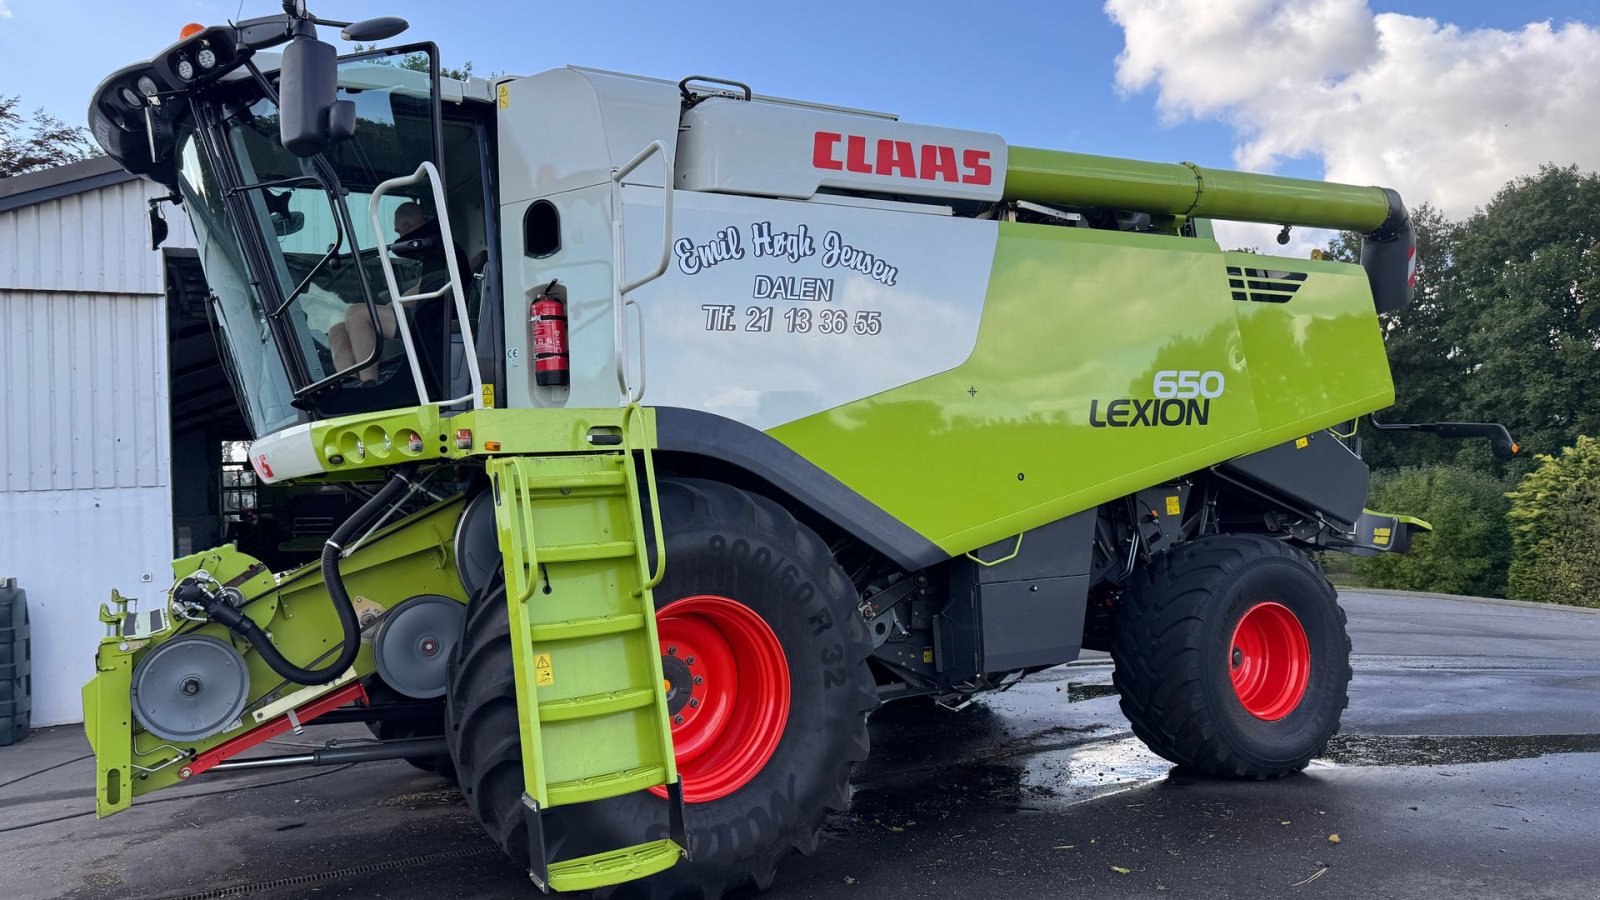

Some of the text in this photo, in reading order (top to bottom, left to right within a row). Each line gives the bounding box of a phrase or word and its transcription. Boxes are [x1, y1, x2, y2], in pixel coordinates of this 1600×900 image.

[813, 131, 992, 186] CLAAS
[674, 221, 899, 286] Emil Høgh Jensen
[753, 275, 834, 301] DALEN
[702, 304, 882, 335] Tlf. 21 13 36 55
[507, 349, 518, 358] CE
[1153, 370, 1225, 399] 650
[1089, 398, 1210, 428] LEXION
[708, 534, 847, 689] 900/60 R 32
